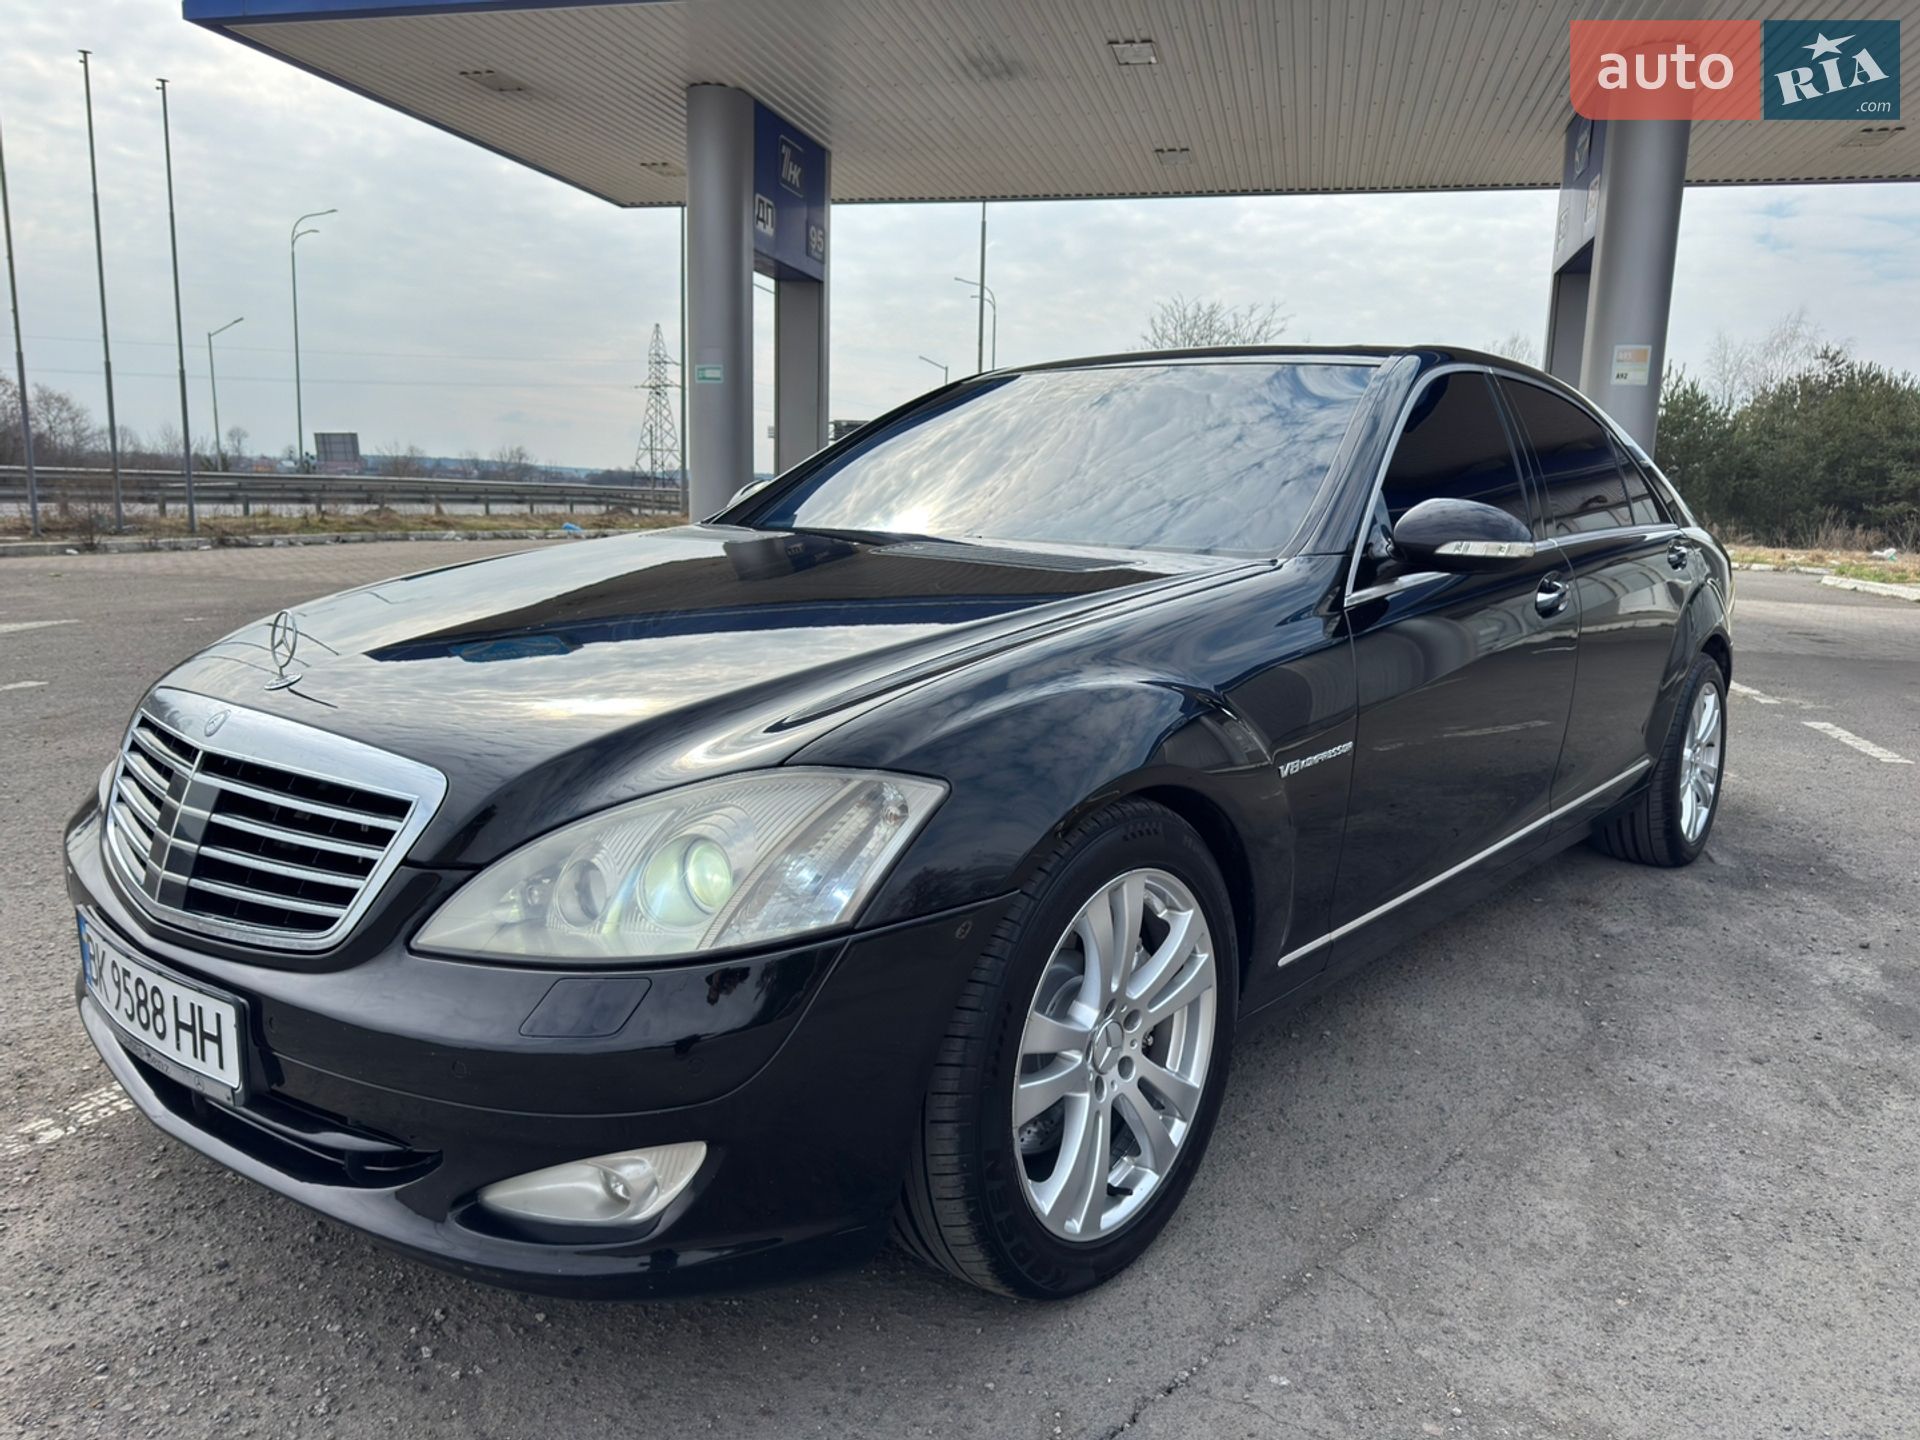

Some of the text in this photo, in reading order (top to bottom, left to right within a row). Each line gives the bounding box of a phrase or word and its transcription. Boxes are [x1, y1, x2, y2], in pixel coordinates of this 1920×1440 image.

[809, 225, 824, 253] 95
[1278, 759, 1300, 779] V8
[111, 959, 167, 1041] 9588
[172, 995, 225, 1071] HH
